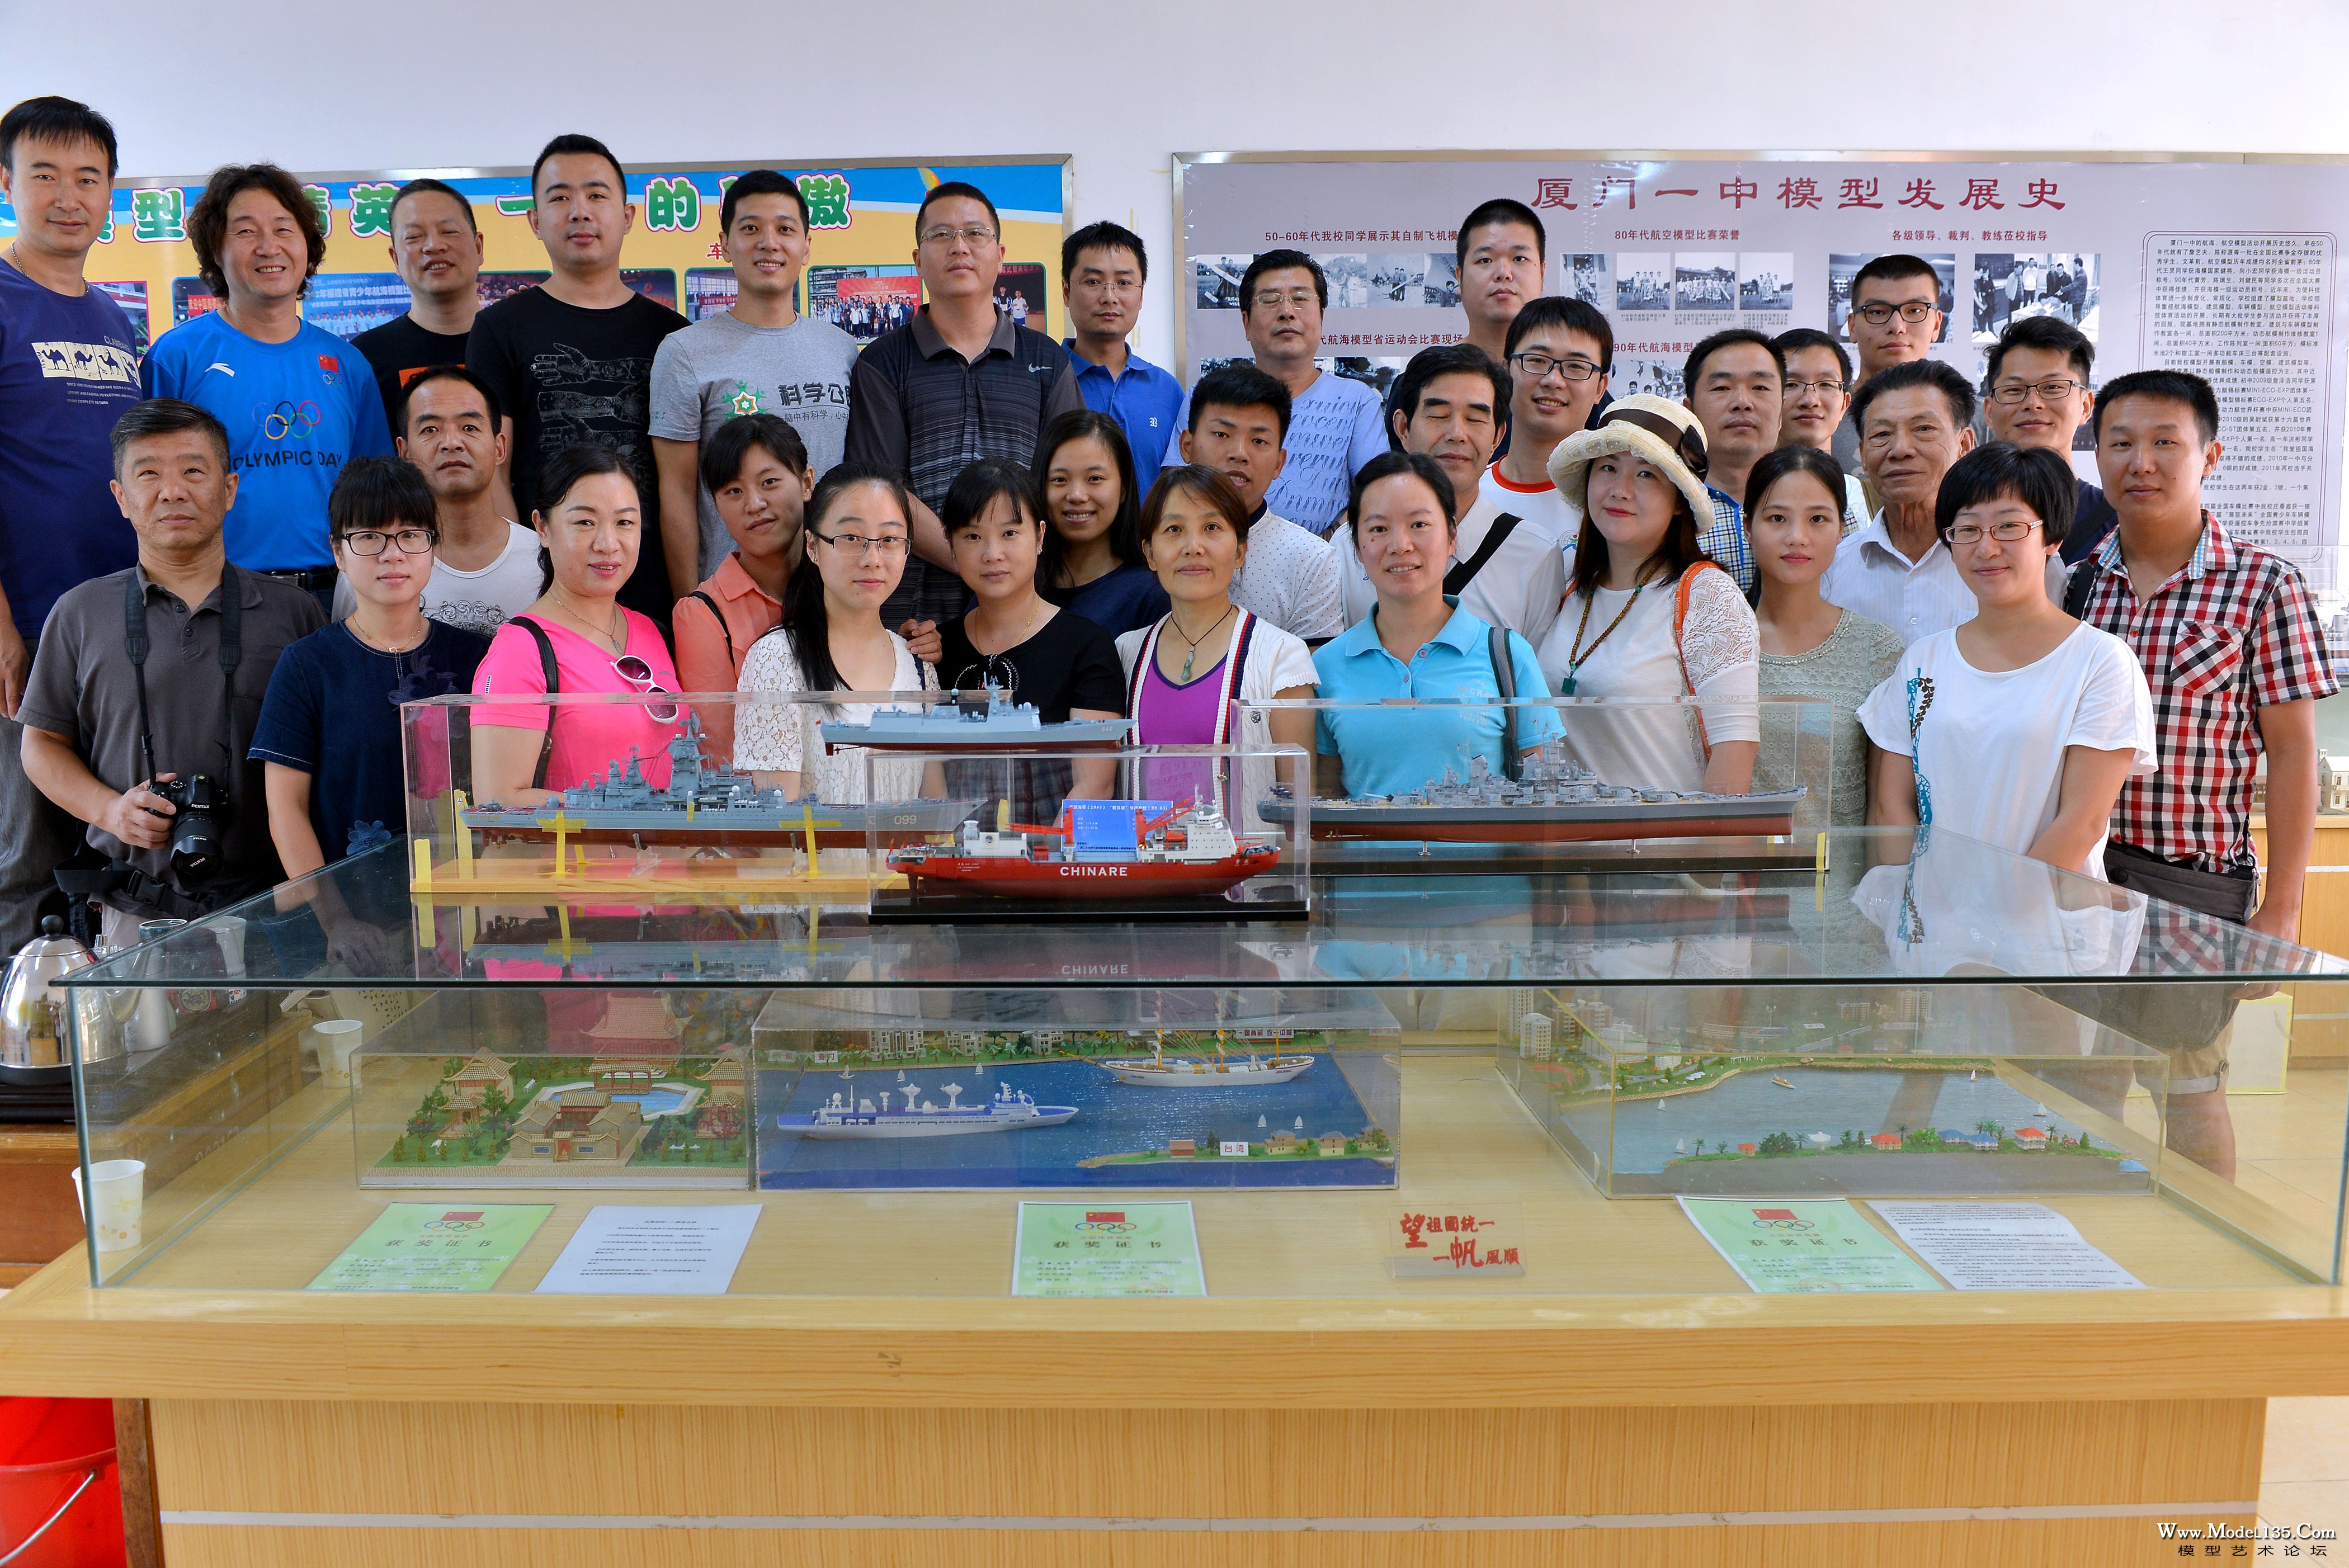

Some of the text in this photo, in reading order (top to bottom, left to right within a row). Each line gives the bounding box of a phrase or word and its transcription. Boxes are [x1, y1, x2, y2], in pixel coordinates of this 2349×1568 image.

[1531, 176, 2066, 210] 厦门一中模型发展史
[1615, 229, 1740, 240] 80年代航空模型比赛荣誉
[1893, 230, 2048, 240] 各级领导、裁判、教练莅校指导
[1614, 342, 1699, 352] 90年代航海模型
[232, 450, 342, 471] OLYMPIC DAY
[894, 815, 917, 825] 099
[1060, 866, 1128, 876] CHINARE
